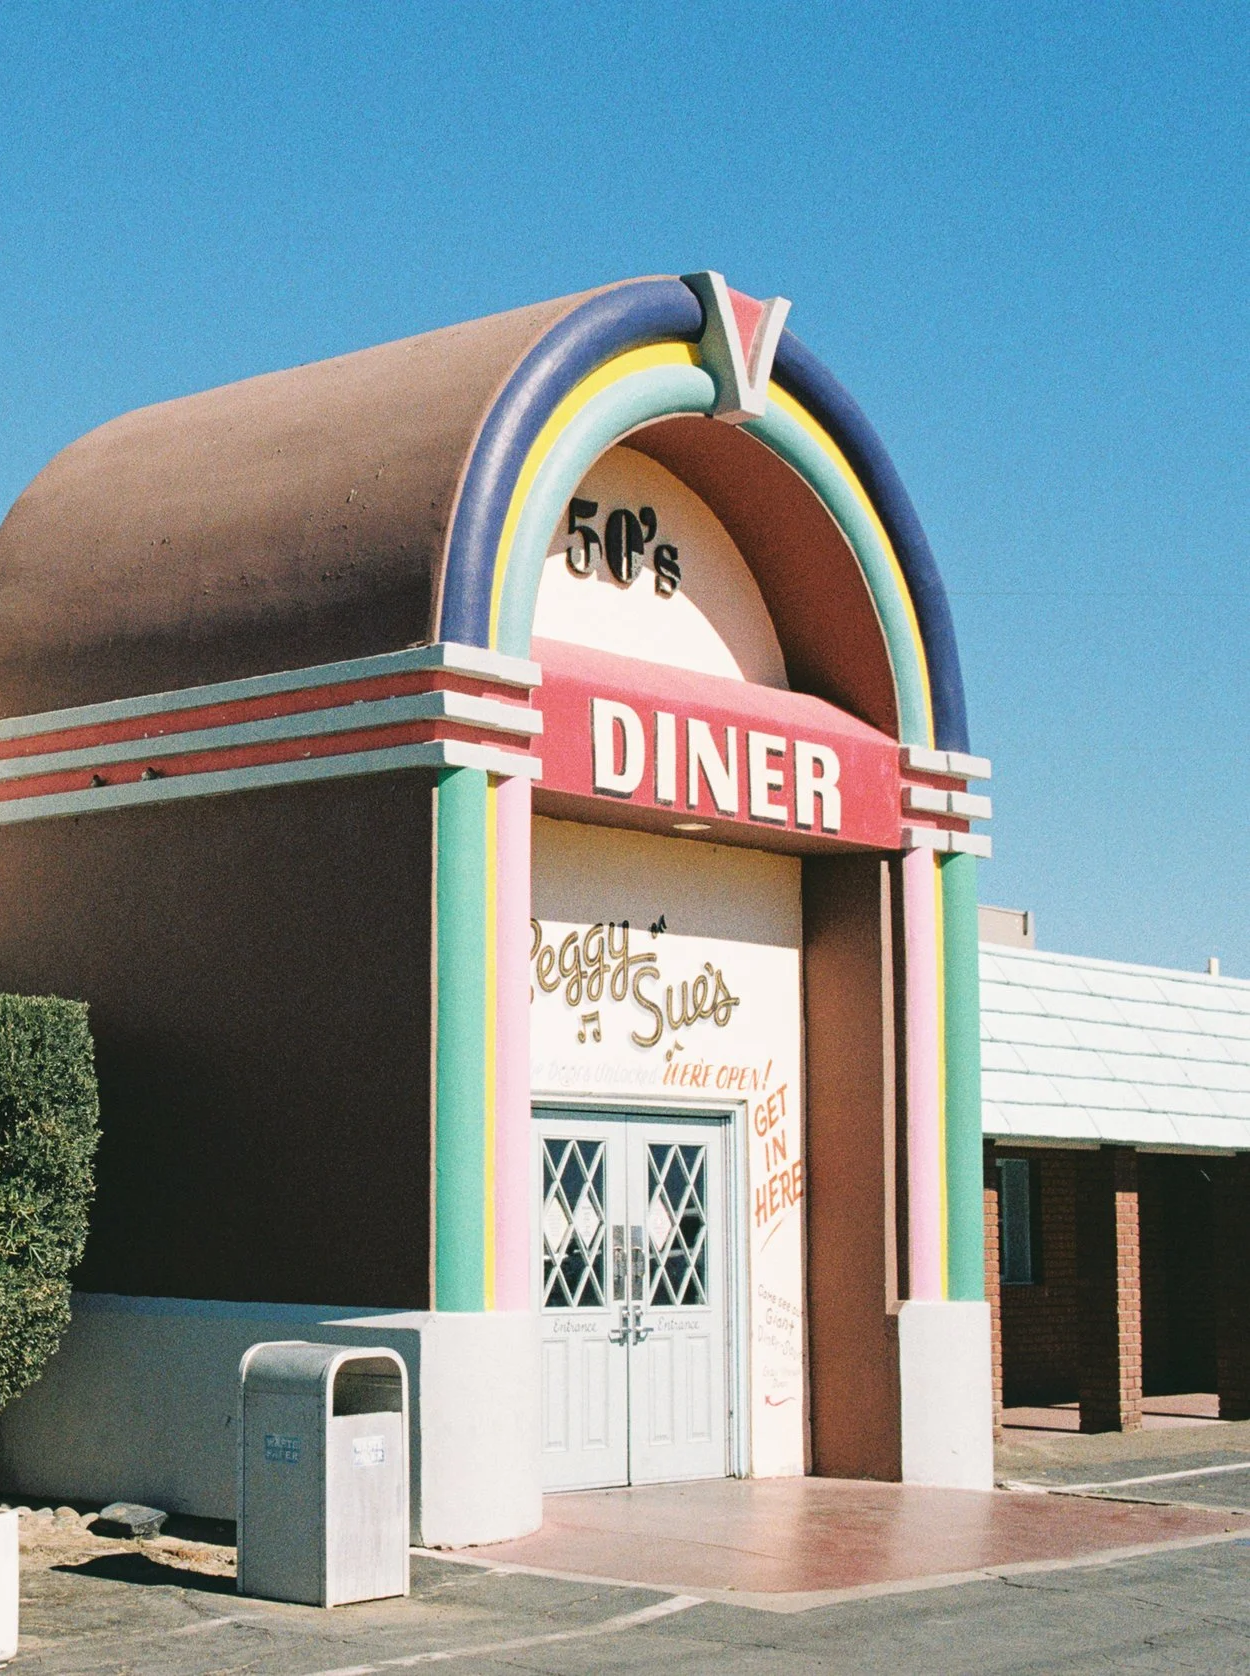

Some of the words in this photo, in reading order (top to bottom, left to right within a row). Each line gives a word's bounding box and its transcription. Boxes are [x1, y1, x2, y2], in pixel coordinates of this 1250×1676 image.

[565, 497, 682, 600] 50's
[590, 697, 842, 835] DINER
[631, 962, 740, 1048] Sue's
[715, 1058, 773, 1091] OPEN!
[754, 1083, 788, 1137] GET
[764, 1129, 787, 1172] IN
[754, 1159, 804, 1228] HERE
[553, 1317, 599, 1334] Entrance
[657, 1315, 701, 1332] Entrance
